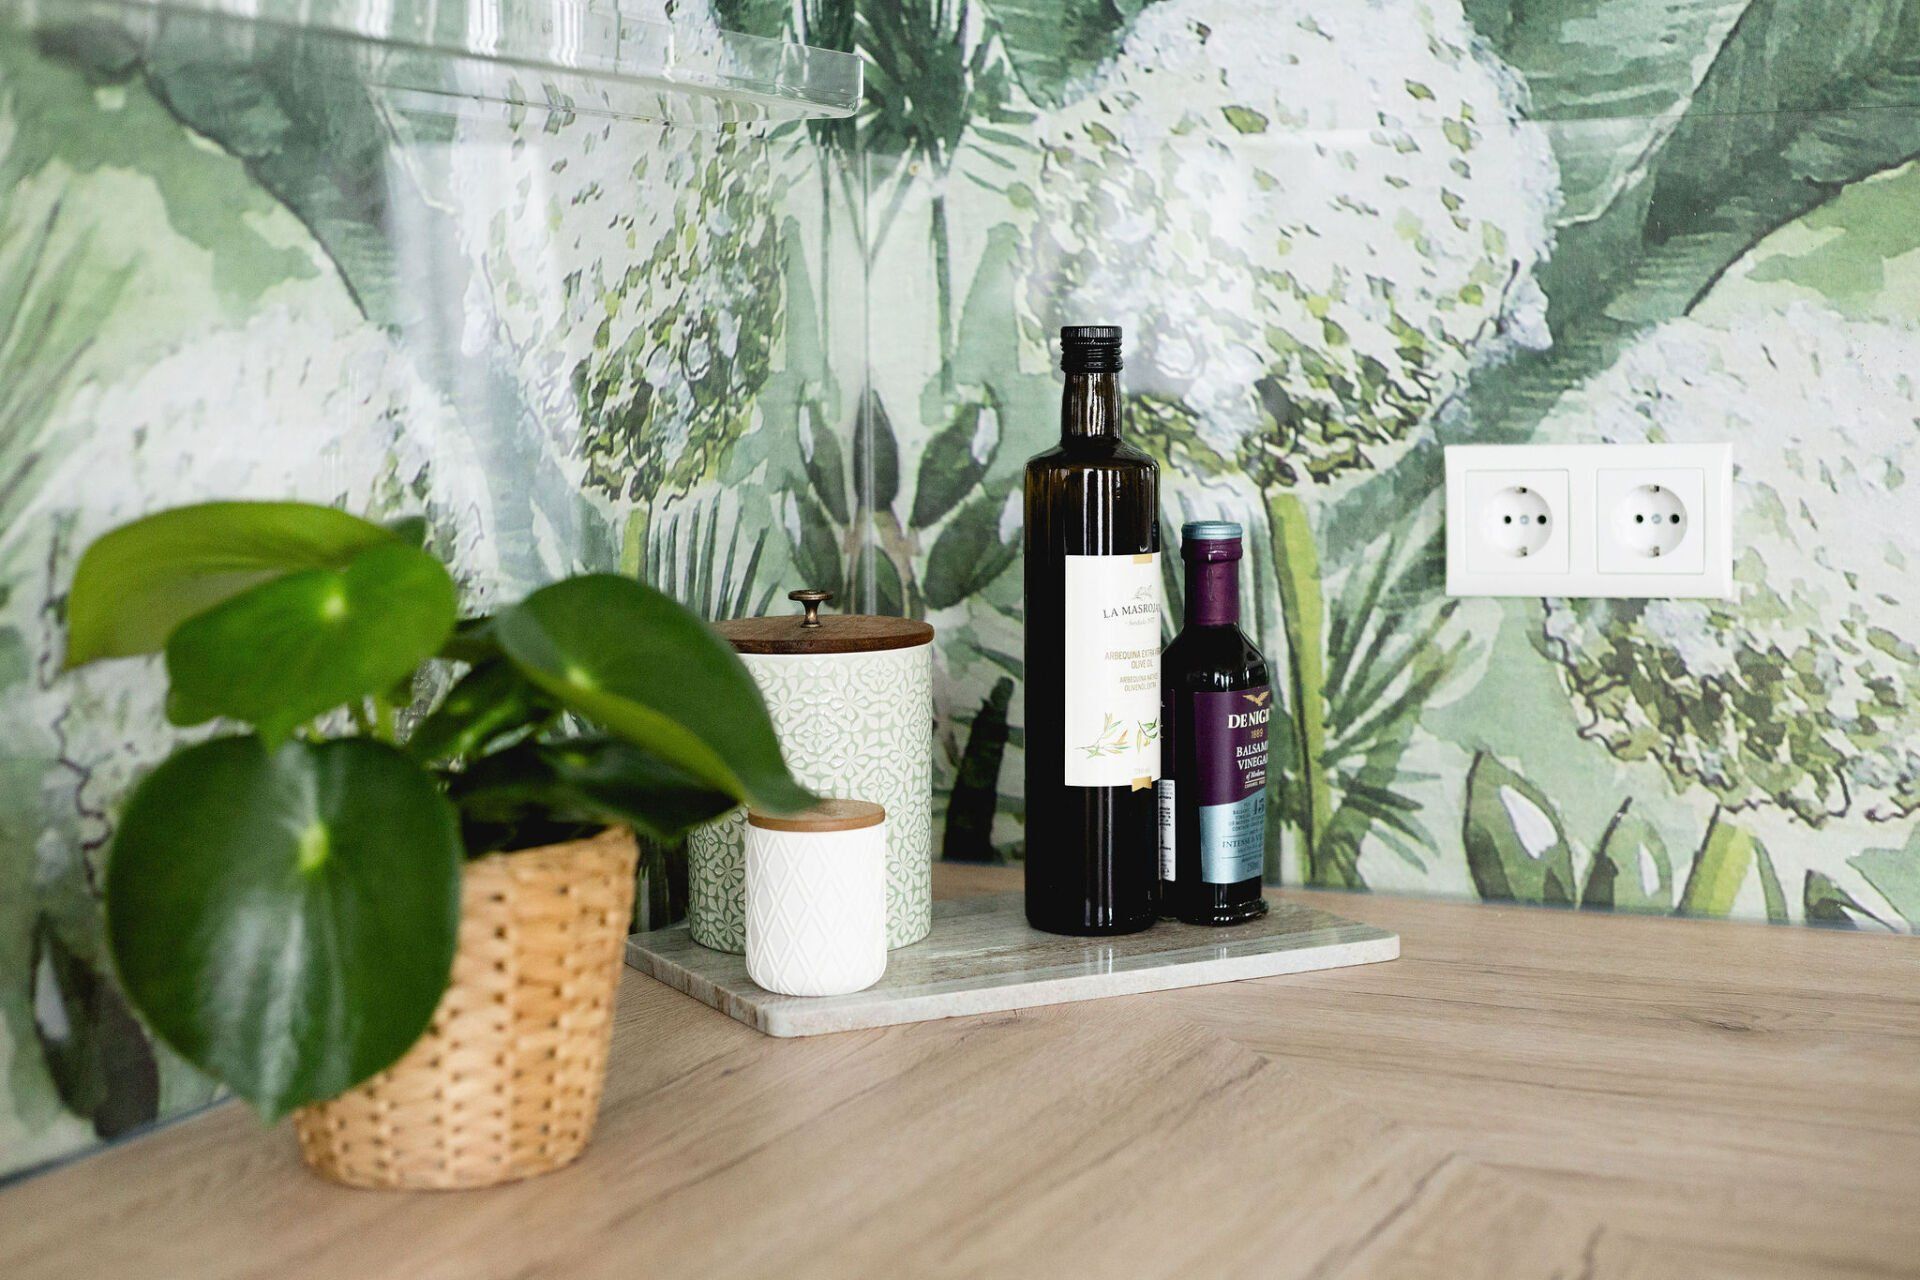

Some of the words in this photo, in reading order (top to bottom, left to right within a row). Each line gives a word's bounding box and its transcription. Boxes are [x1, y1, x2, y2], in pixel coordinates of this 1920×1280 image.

[1103, 608, 1119, 618] LA
[1122, 603, 1160, 615] MASROJA
[1105, 651, 1141, 660] ARBEQUINA
[1228, 714, 1247, 728] DE
